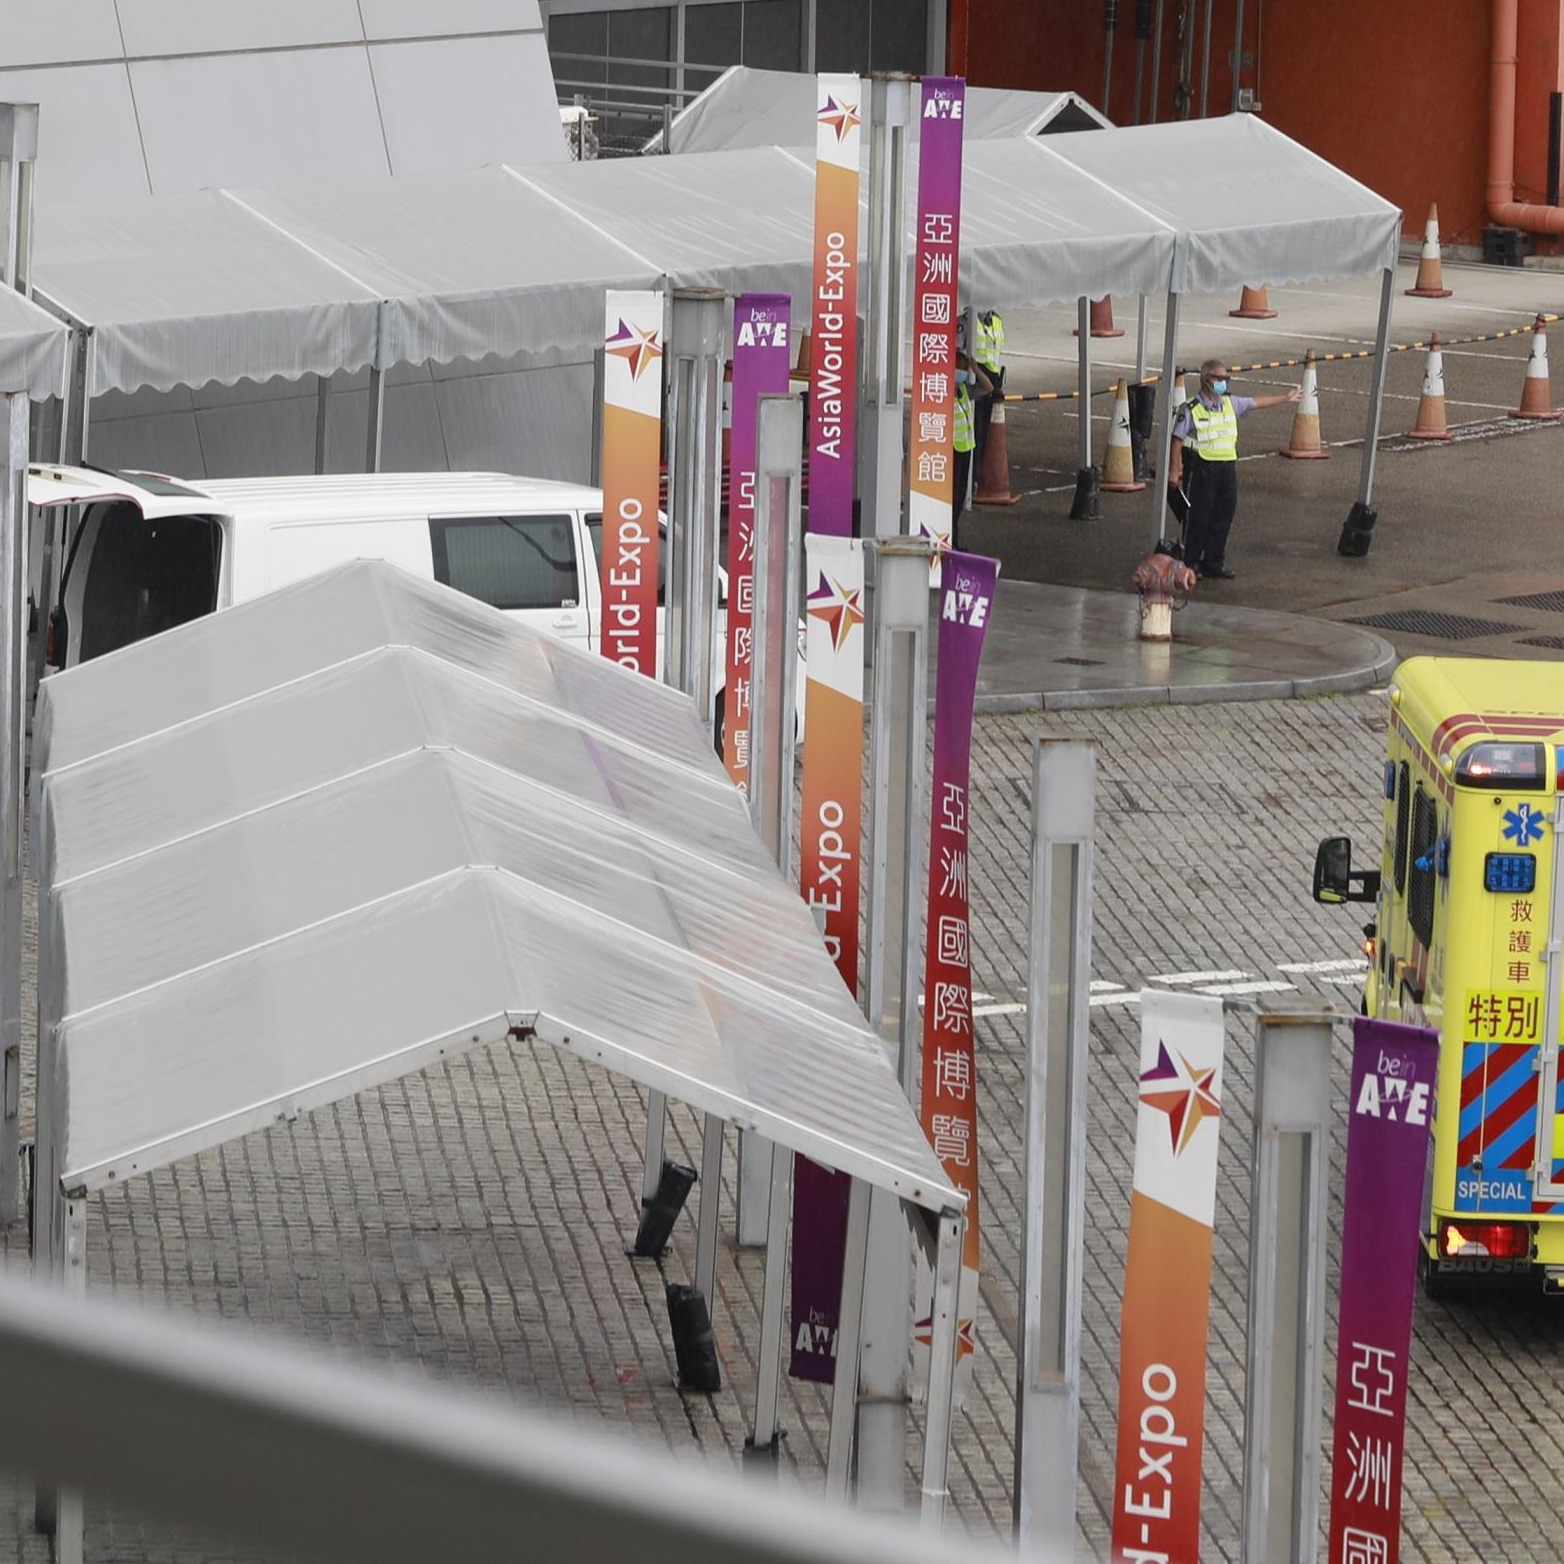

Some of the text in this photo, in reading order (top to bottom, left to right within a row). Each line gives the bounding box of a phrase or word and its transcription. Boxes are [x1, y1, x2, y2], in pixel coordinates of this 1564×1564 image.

[924, 100, 962, 119] AWE
[737, 322, 787, 347] AWE
[816, 232, 851, 459] AsiaWorld-Expo
[917, 213, 953, 483] 亞洲國際博覽館
[943, 591, 989, 627] AWE
[1507, 899, 1533, 984] 救護車
[933, 782, 972, 1231] 亞洲國際博覽
[1468, 994, 1539, 1039] 特別
[1355, 1073, 1430, 1126] AWE
[1457, 1181, 1527, 1200] SPECIAL
